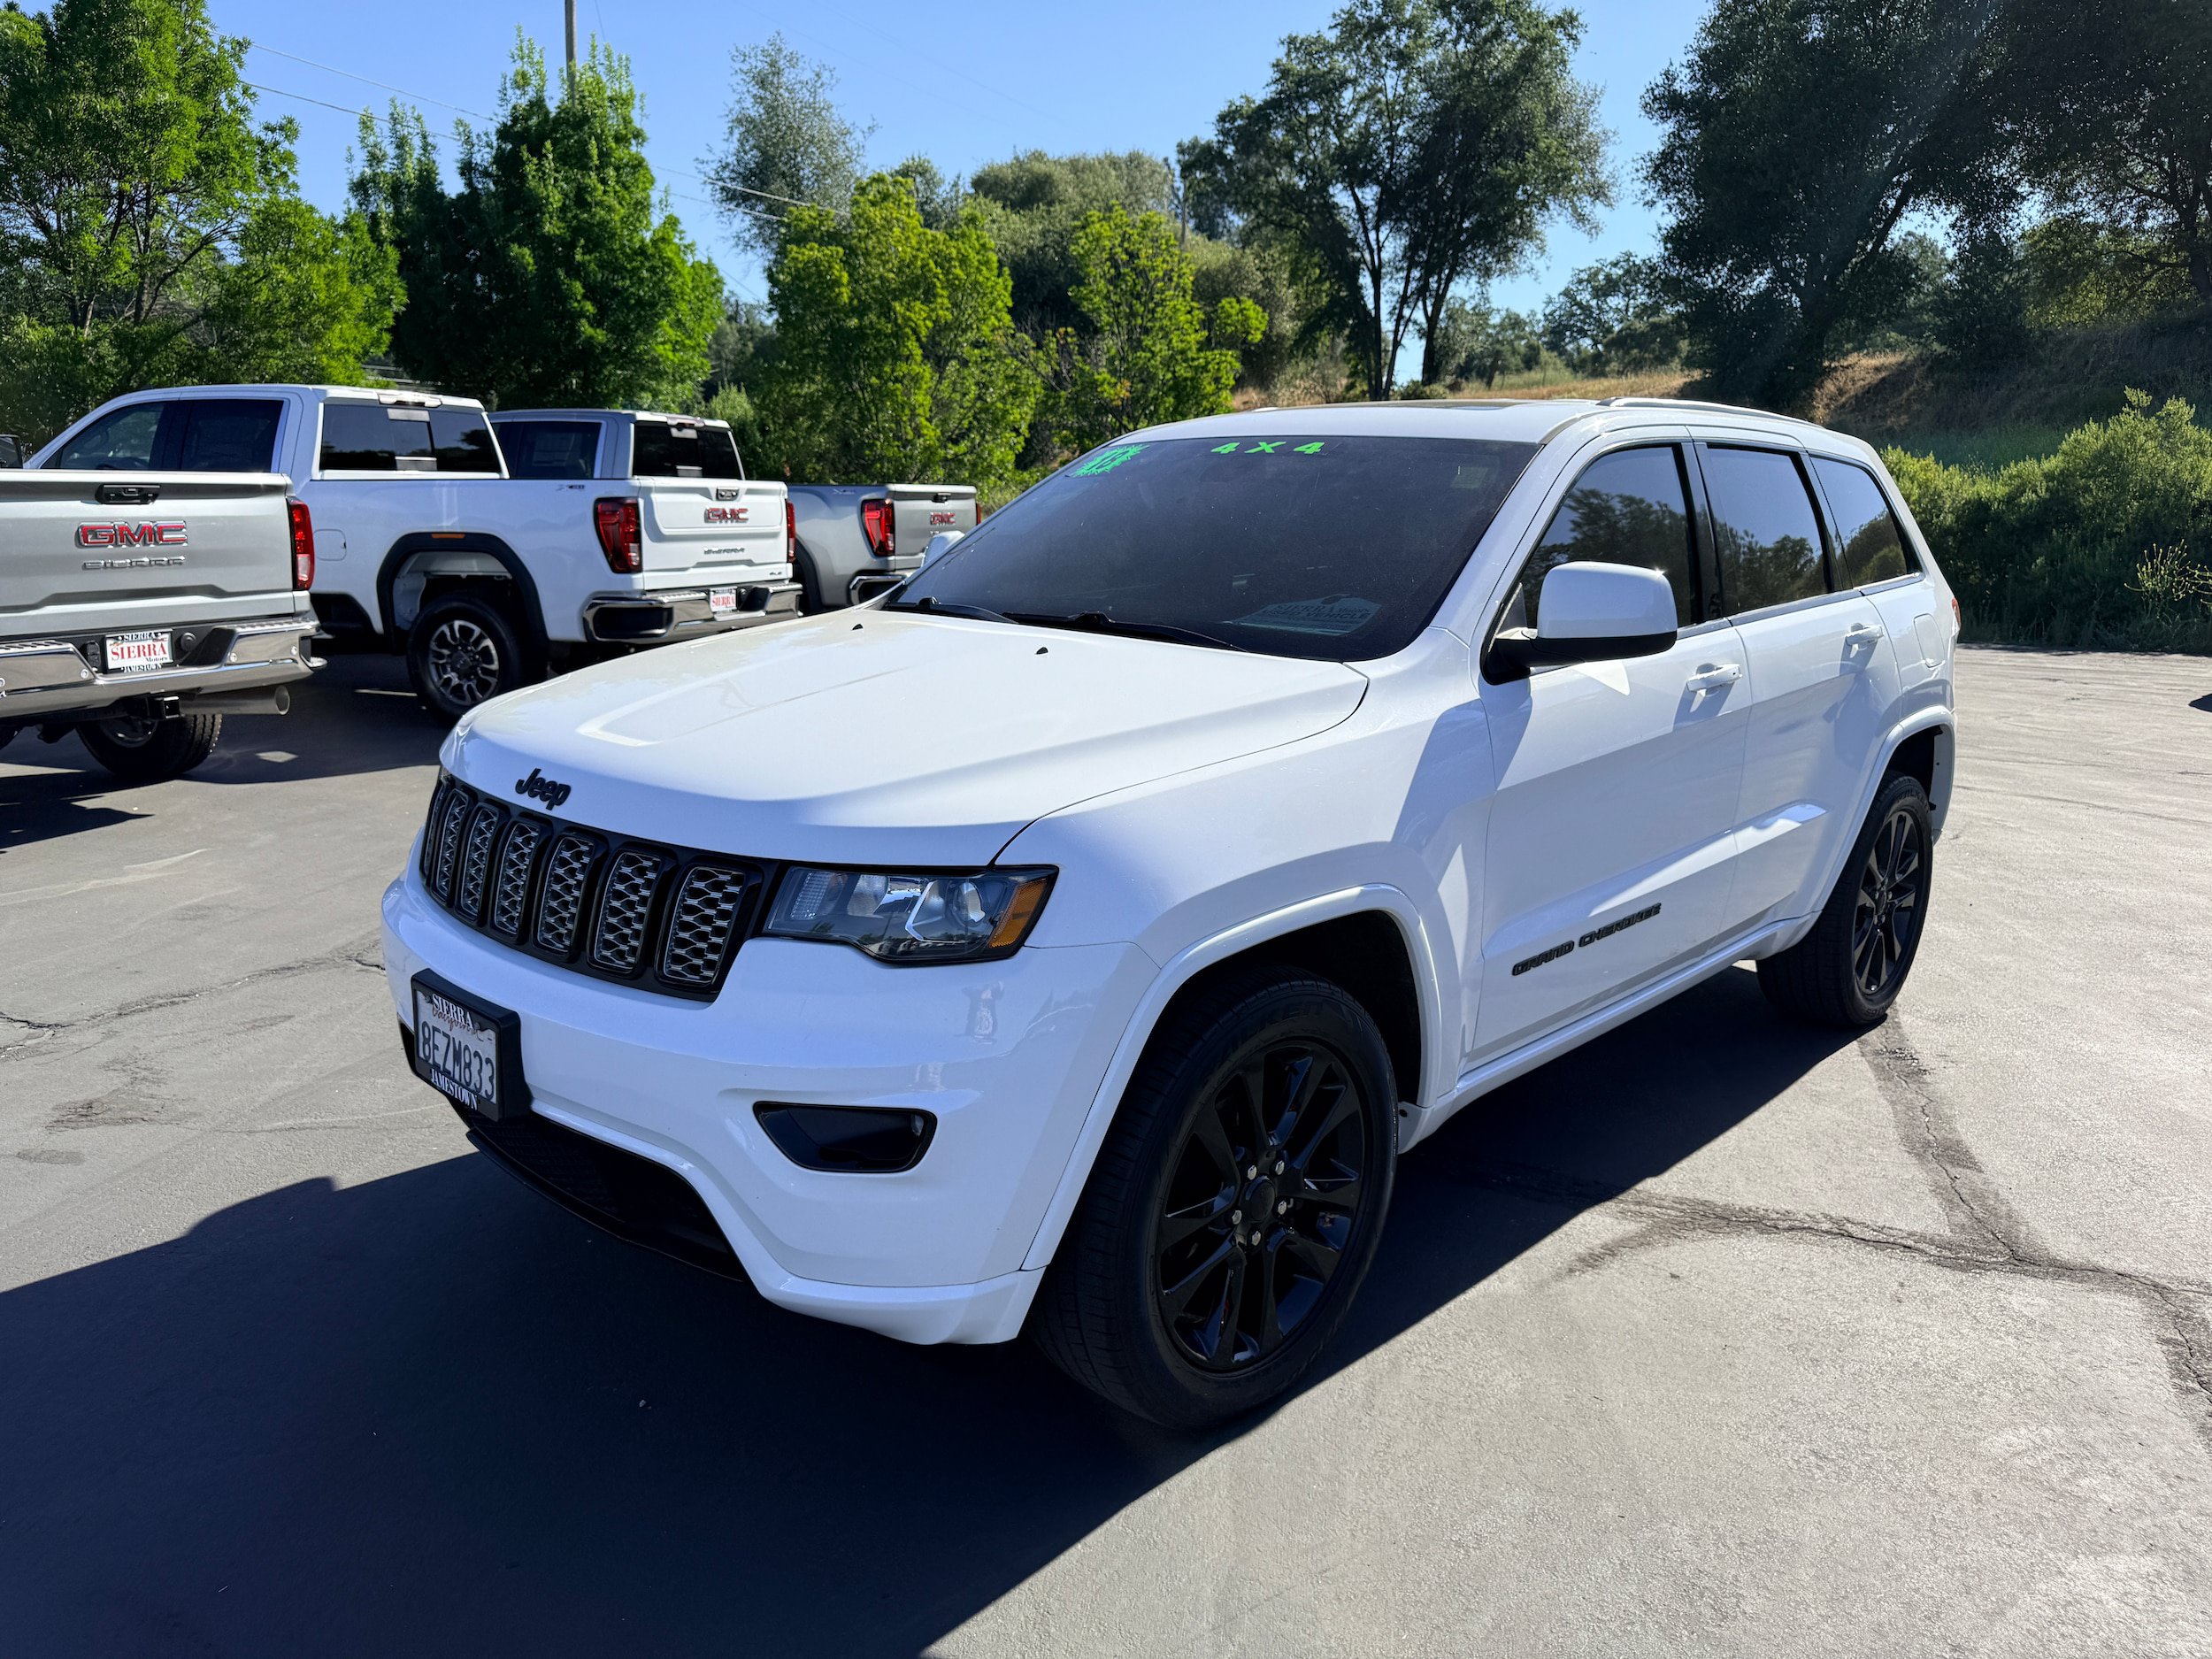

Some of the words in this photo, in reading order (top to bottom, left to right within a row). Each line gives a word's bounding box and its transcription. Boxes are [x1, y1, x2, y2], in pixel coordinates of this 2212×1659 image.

[706, 507, 749, 522] GMC
[931, 511, 956, 526] GMC
[78, 520, 188, 548] GMC
[111, 642, 166, 662] SIERRA
[124, 632, 156, 642] SIERRA
[515, 767, 572, 811] Jeep
[1512, 940, 1575, 976] GRAND
[1578, 902, 1662, 948] CHEROKEE
[432, 993, 474, 1029] SIERRA
[421, 1020, 495, 1101] 8EZM833
[431, 1068, 478, 1110] JAMESTOWN
